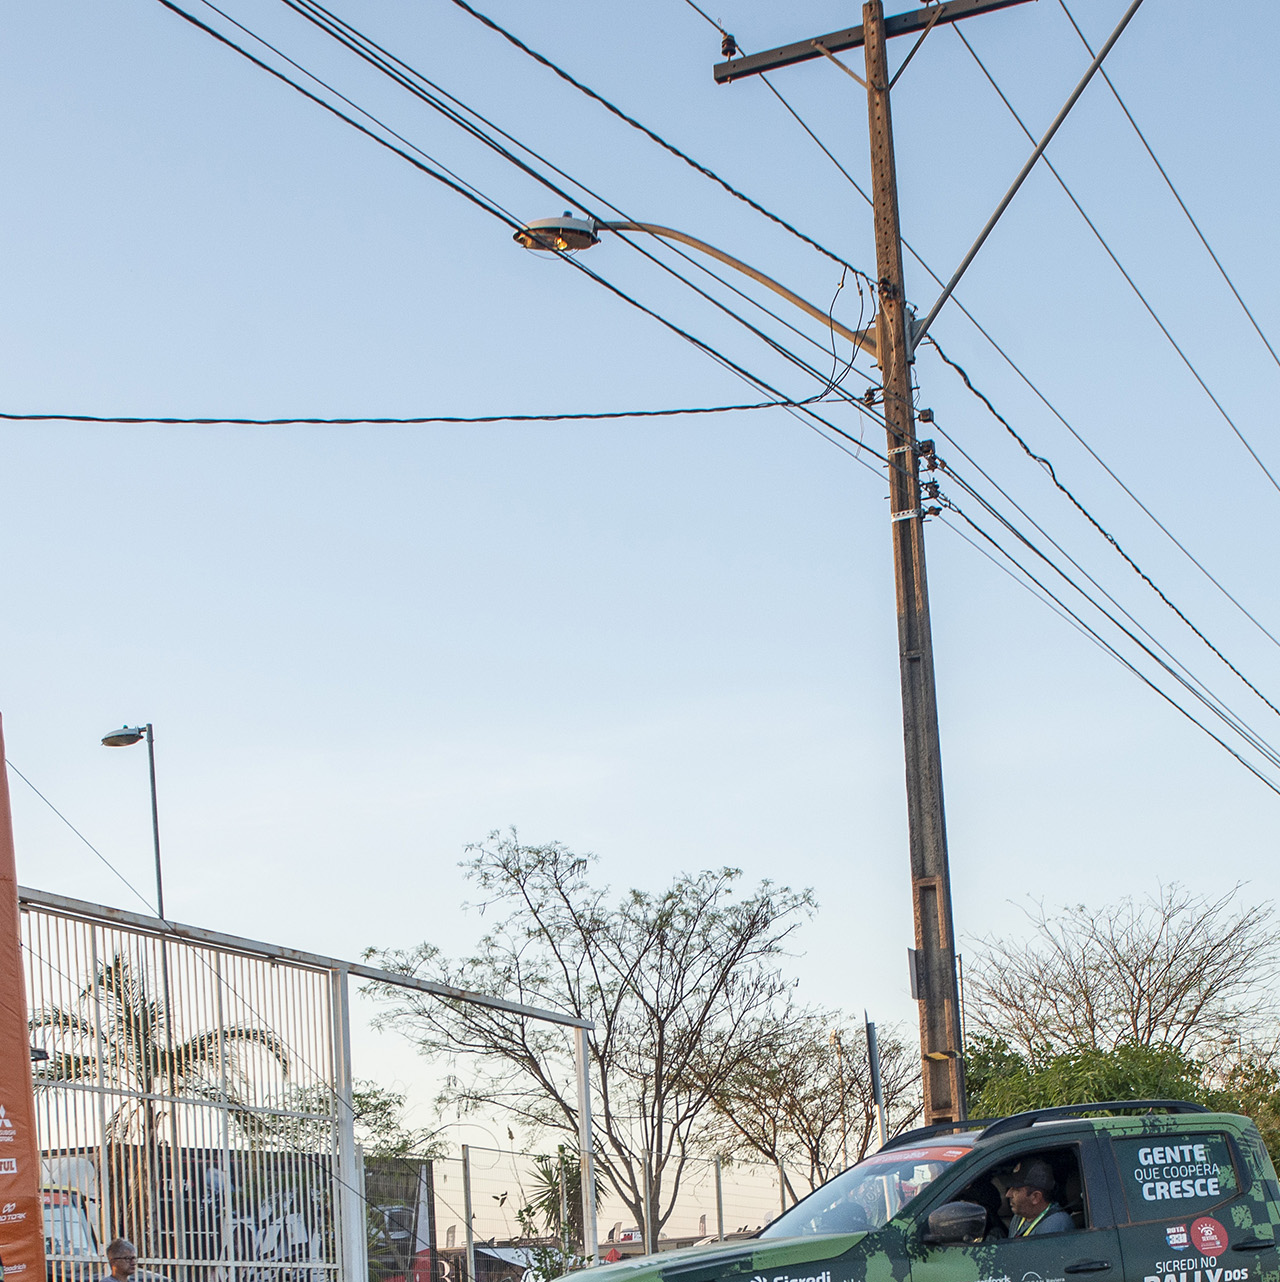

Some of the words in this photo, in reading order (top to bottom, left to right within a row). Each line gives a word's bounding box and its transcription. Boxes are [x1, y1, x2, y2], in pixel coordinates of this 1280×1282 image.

[1138, 1144, 1207, 1165] GENTE
[1134, 1167, 1160, 1183] QUE
[1163, 1163, 1220, 1179] COOPERA
[1142, 1178, 1220, 1200] CRESCE
[7, 1212, 27, 1220] TORK
[1156, 1258, 1198, 1274] SICREDI
[1200, 1256, 1217, 1268] NO
[1224, 1268, 1248, 1281] DOS
